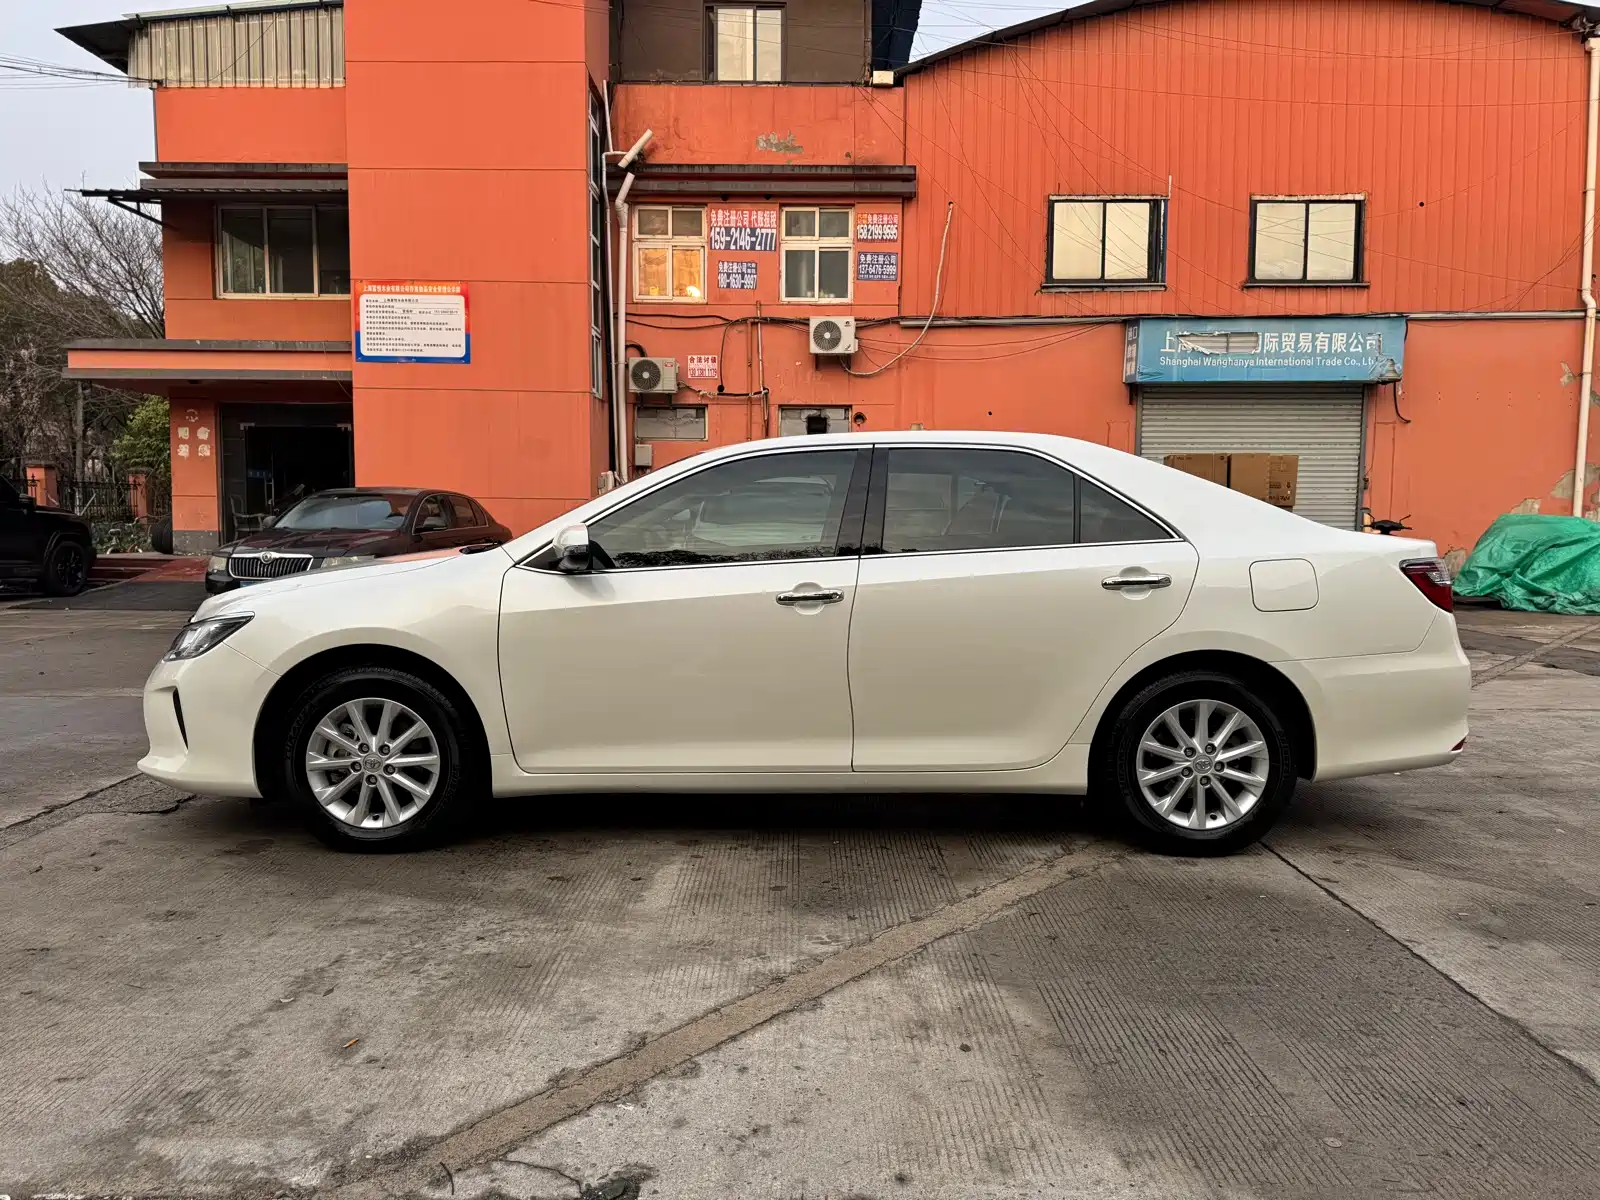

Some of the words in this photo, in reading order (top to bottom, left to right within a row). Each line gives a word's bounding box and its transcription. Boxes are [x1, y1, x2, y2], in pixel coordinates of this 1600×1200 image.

[710, 209, 750, 227] 免费注册公司
[868, 213, 898, 224] 免费注册公司
[710, 227, 777, 251] 159-2146-2777
[859, 254, 896, 264] 免费注册公司
[718, 261, 747, 273] 免费注册公司
[1160, 356, 1201, 368] Shanghai
[1203, 357, 1254, 368] Wanghanya
[1256, 356, 1314, 366] International
[1316, 356, 1341, 366] Trade
